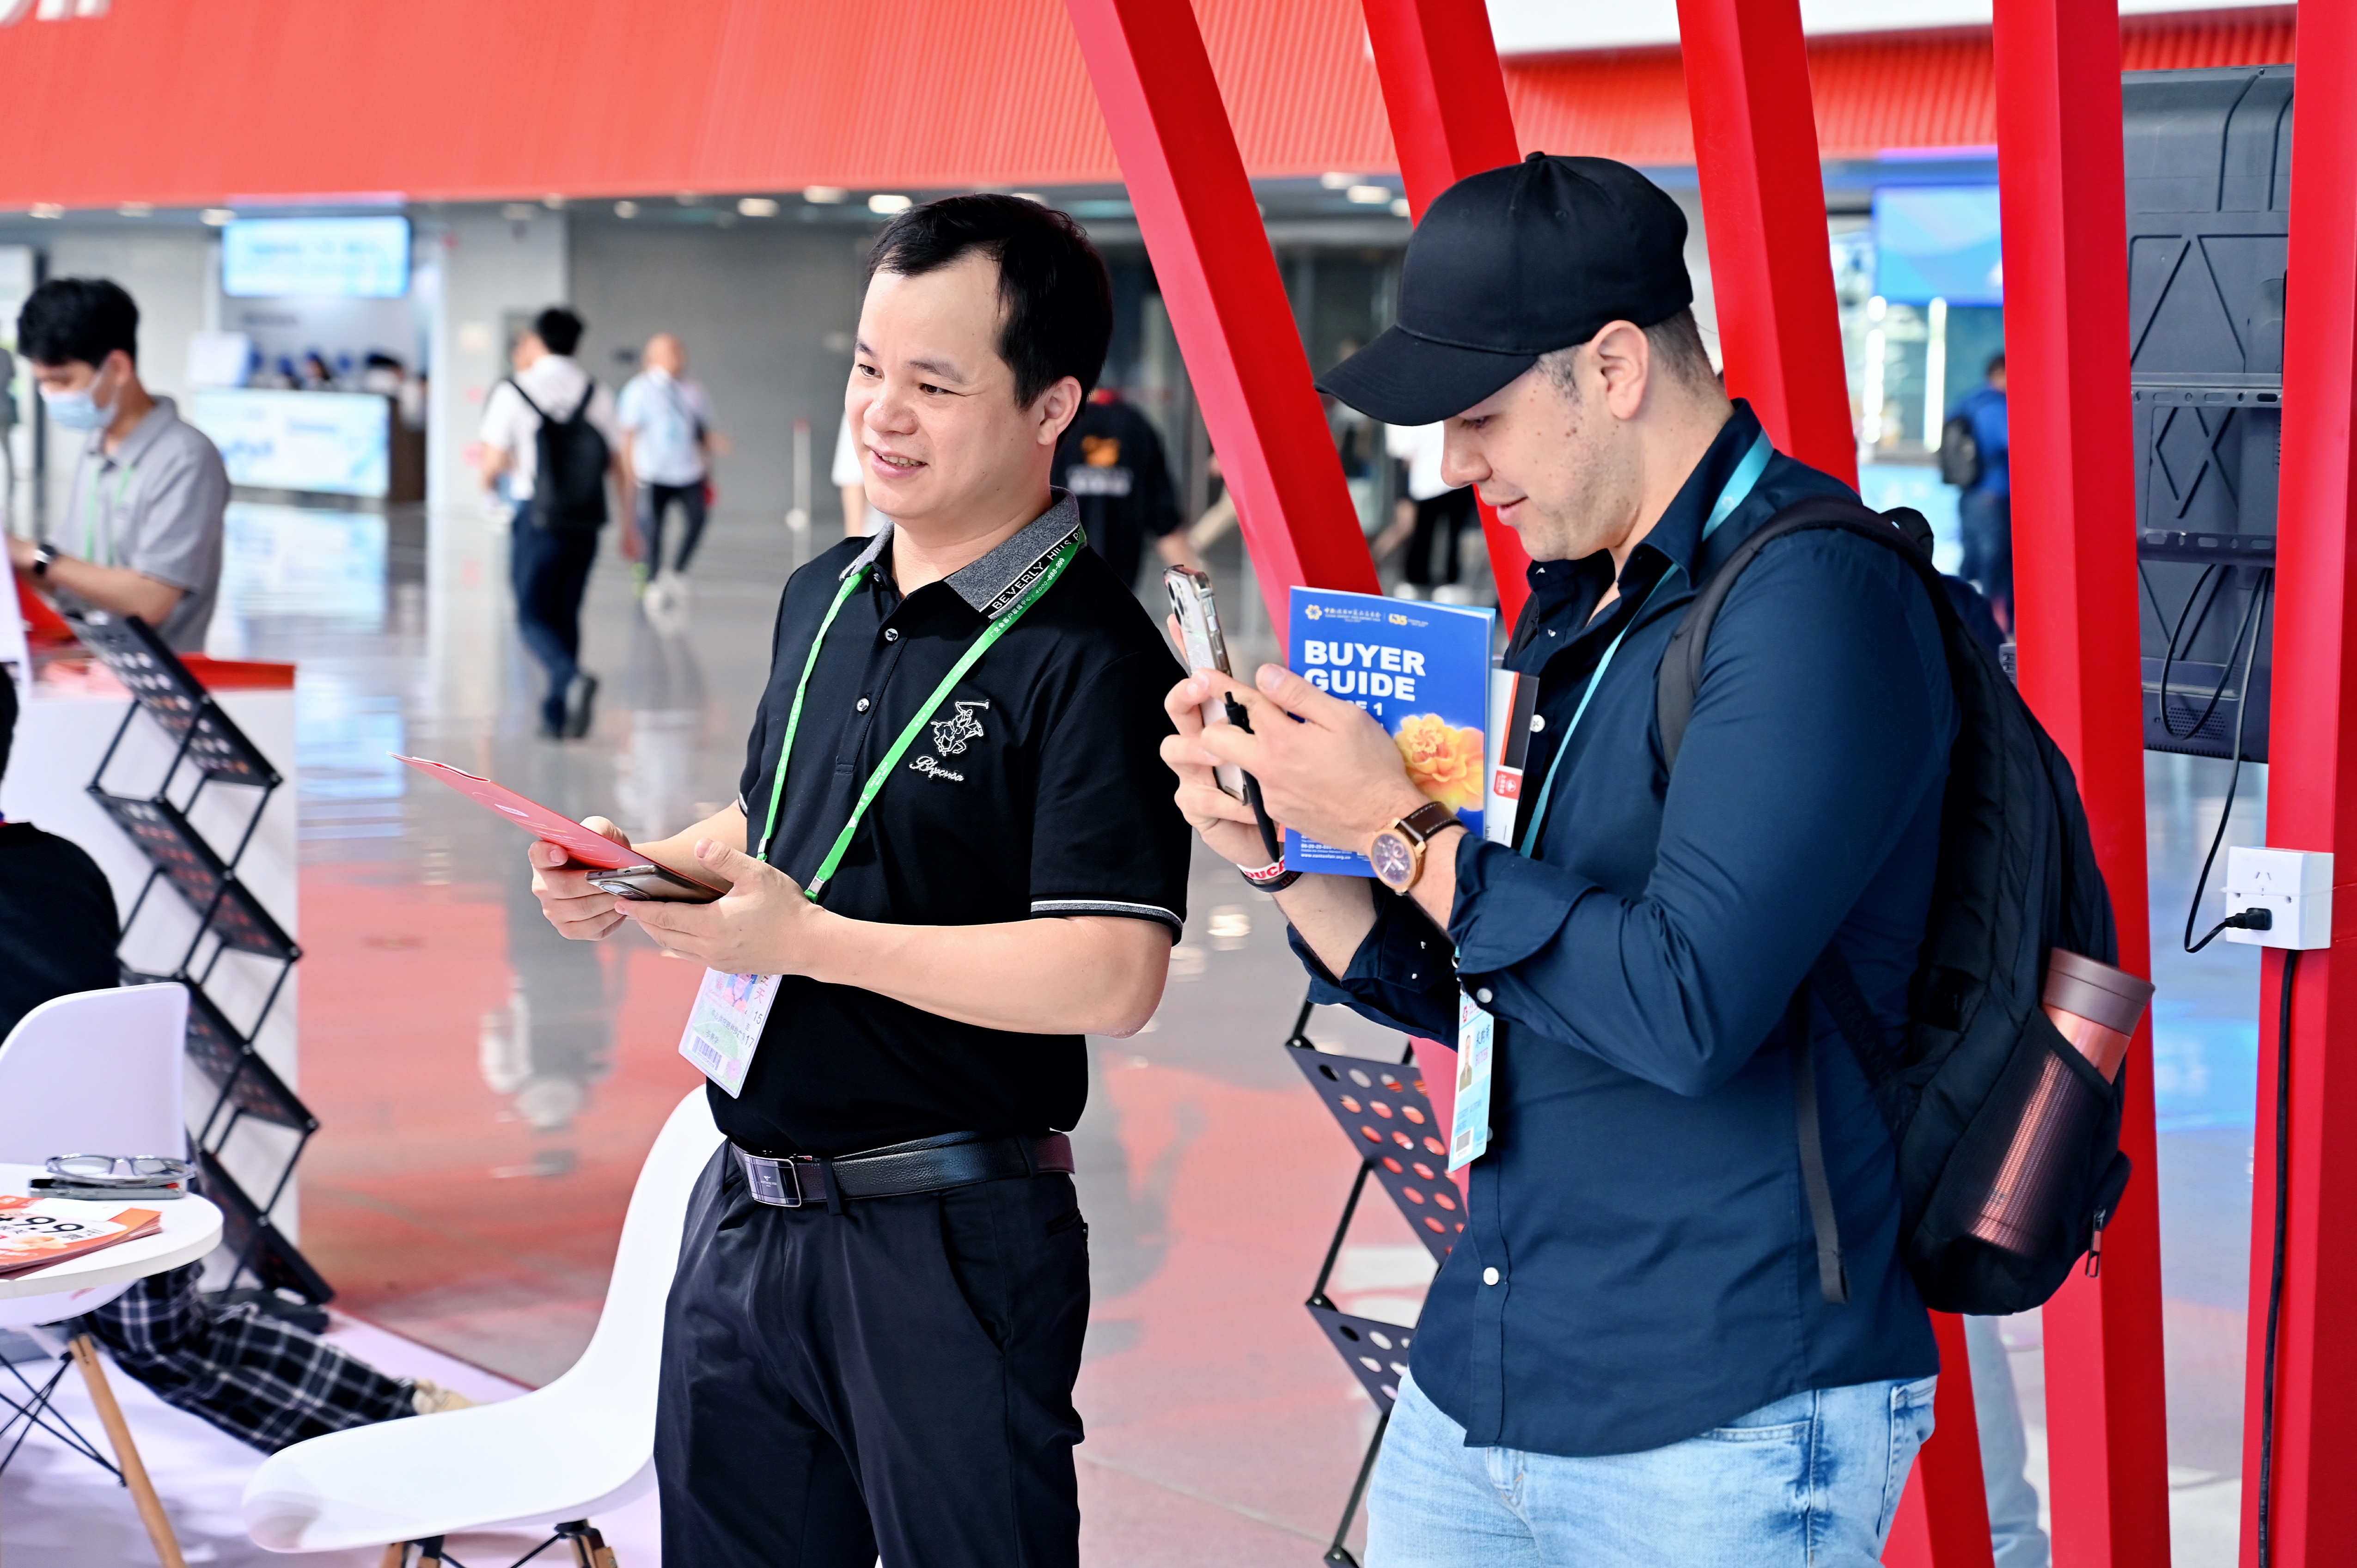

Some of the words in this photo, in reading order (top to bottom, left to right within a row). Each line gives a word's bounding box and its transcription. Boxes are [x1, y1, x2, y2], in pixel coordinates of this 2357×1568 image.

[992, 561, 1044, 610] BEVERLY
[1304, 640, 1426, 677] BUYER
[1304, 668, 1416, 702] GUIDE
[1373, 702, 1383, 716] 1
[868, 771, 881, 789] CANTON
[753, 1011, 763, 1025] 15
[745, 1035, 755, 1048] 17
